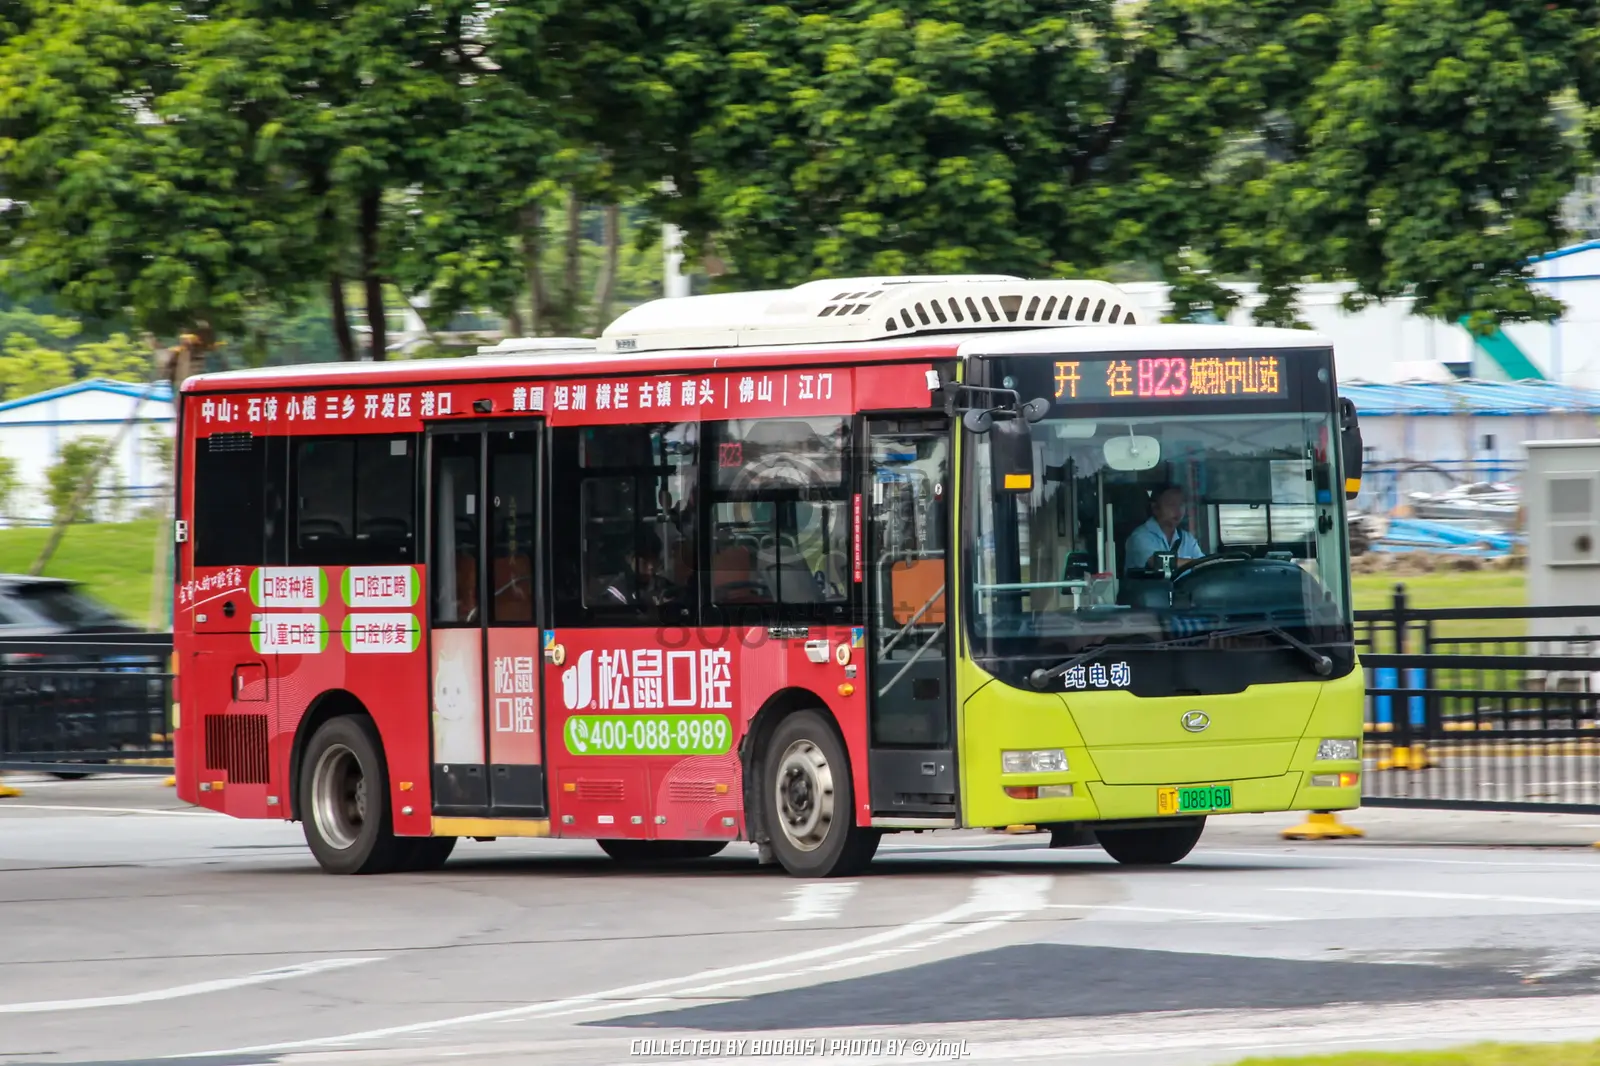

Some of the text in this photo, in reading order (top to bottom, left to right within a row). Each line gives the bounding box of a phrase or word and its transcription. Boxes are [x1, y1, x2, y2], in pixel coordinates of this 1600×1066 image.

[1137, 357, 1187, 396] B23
[324, 394, 356, 420] 三乡
[364, 393, 412, 418] 开发区
[420, 392, 452, 417] 港口
[553, 385, 587, 411] 坦洲
[595, 383, 630, 410] 横栏
[638, 381, 672, 408] 古镇
[680, 379, 715, 406] 南头
[738, 375, 774, 403] 佛山
[797, 372, 834, 401] 江门
[263, 575, 315, 599] 口腔种植
[354, 574, 406, 598] 口腔正畸
[264, 622, 316, 646] 儿童口腔
[355, 621, 407, 645] 口腔修复
[494, 656, 534, 694] 松鼠
[598, 648, 733, 710] 松鼠口腔
[1063, 662, 1131, 688] 纯电动
[495, 696, 535, 734] 口腔
[590, 719, 727, 750] 400-088-8989
